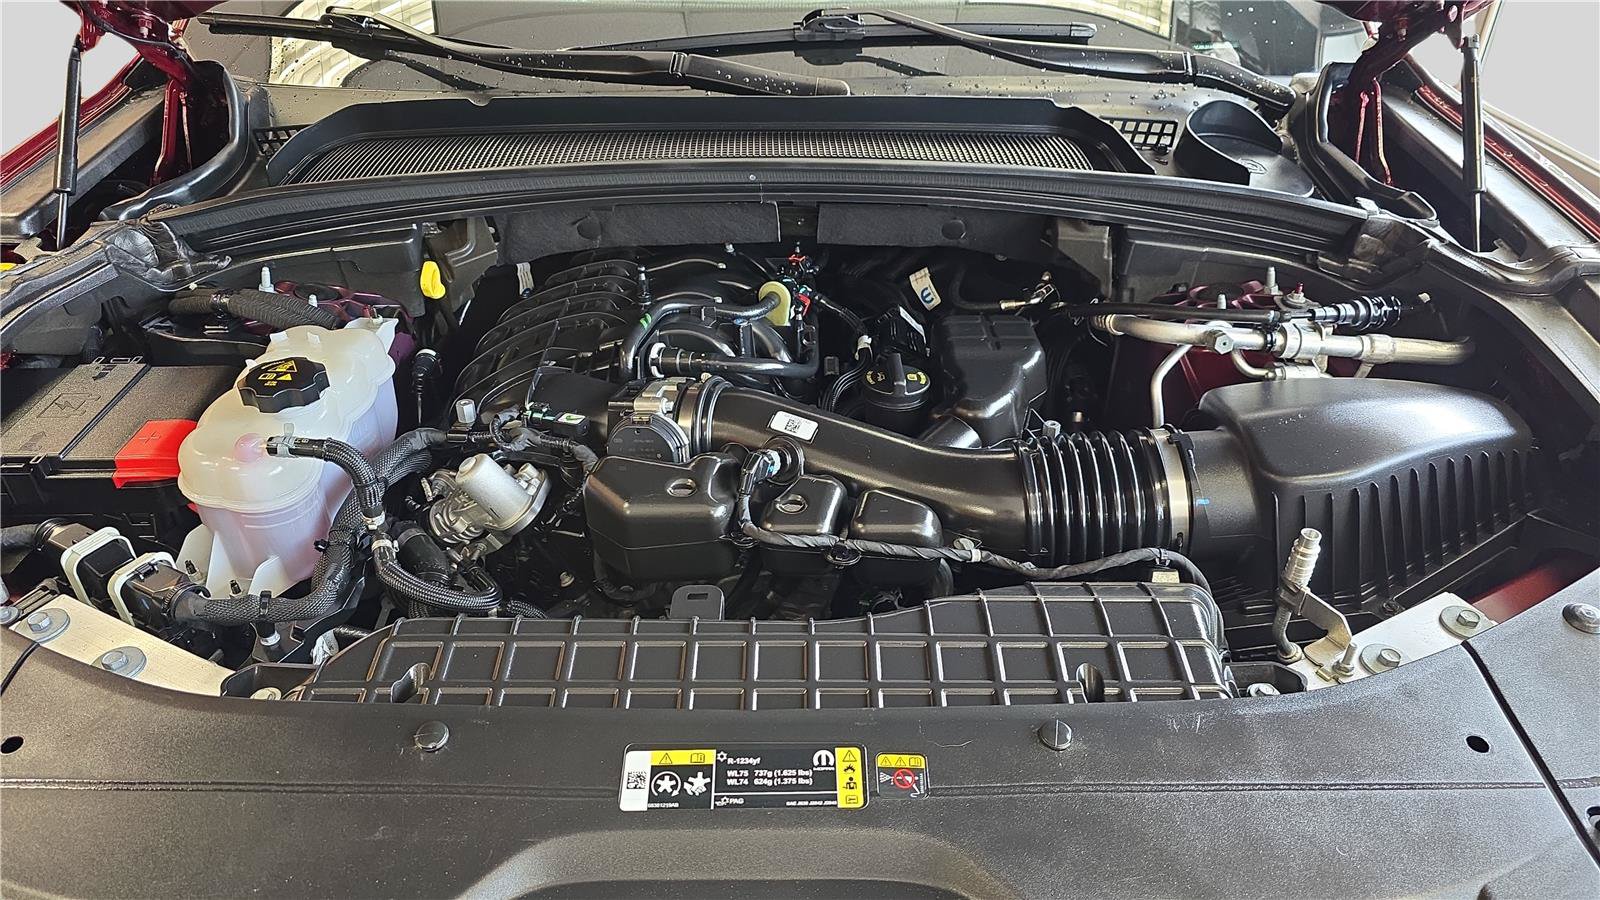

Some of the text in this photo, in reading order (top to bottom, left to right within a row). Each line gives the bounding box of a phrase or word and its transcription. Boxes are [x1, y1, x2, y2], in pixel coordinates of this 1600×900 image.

[727, 757, 761, 765] R-1234yf
[727, 769, 813, 778] WL75 737g (1.625 lbs)
[727, 777, 813, 787] WL74 624g (1.375 lbs)
